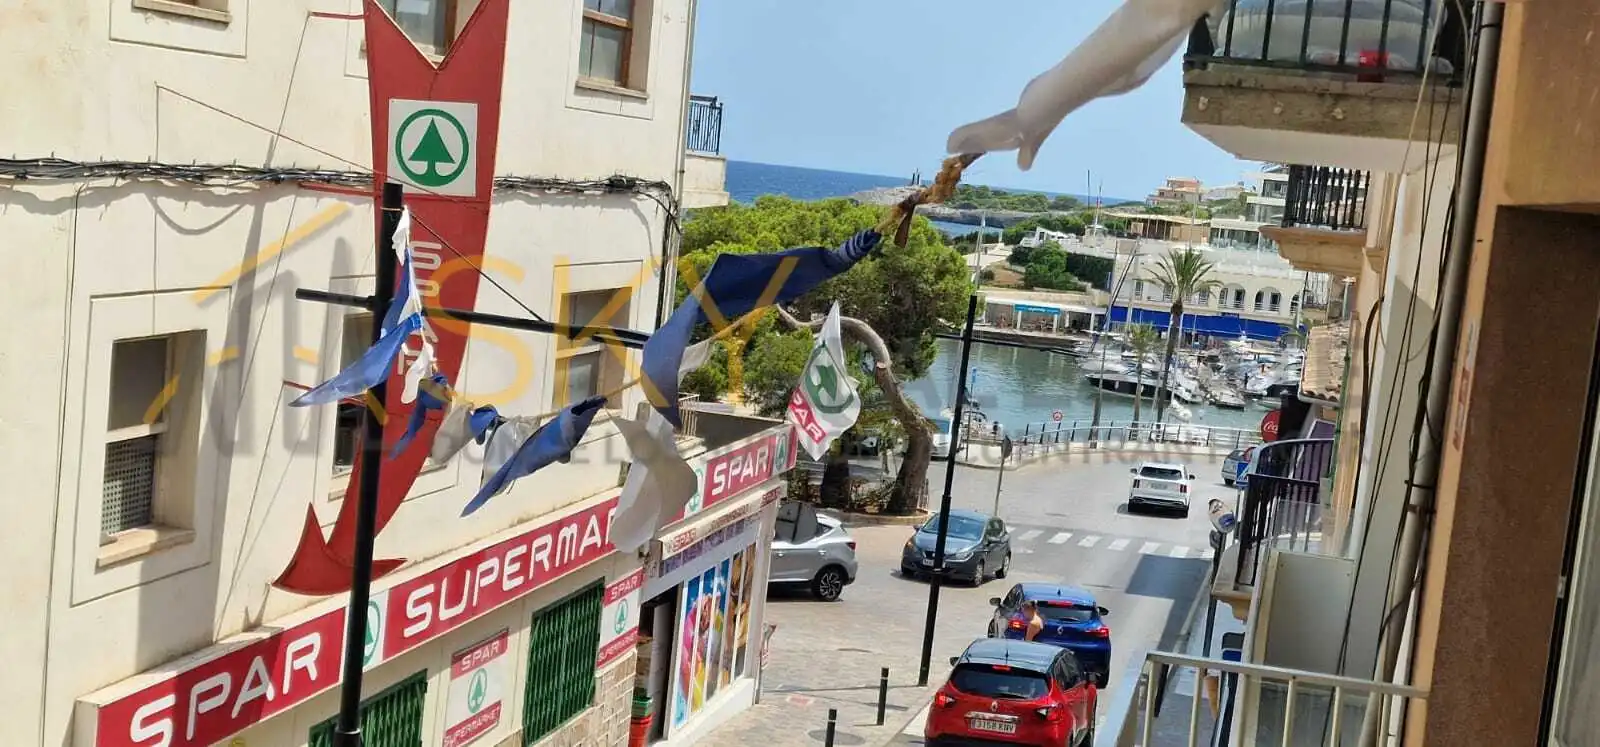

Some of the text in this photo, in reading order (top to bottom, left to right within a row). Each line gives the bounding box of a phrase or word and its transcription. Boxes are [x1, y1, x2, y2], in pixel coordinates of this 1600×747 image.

[711, 445, 769, 496] SPAR
[403, 507, 617, 638] SUPERMA
[611, 575, 638, 600] SPAR
[461, 640, 500, 671] SPAR
[130, 631, 321, 747] SPAR
